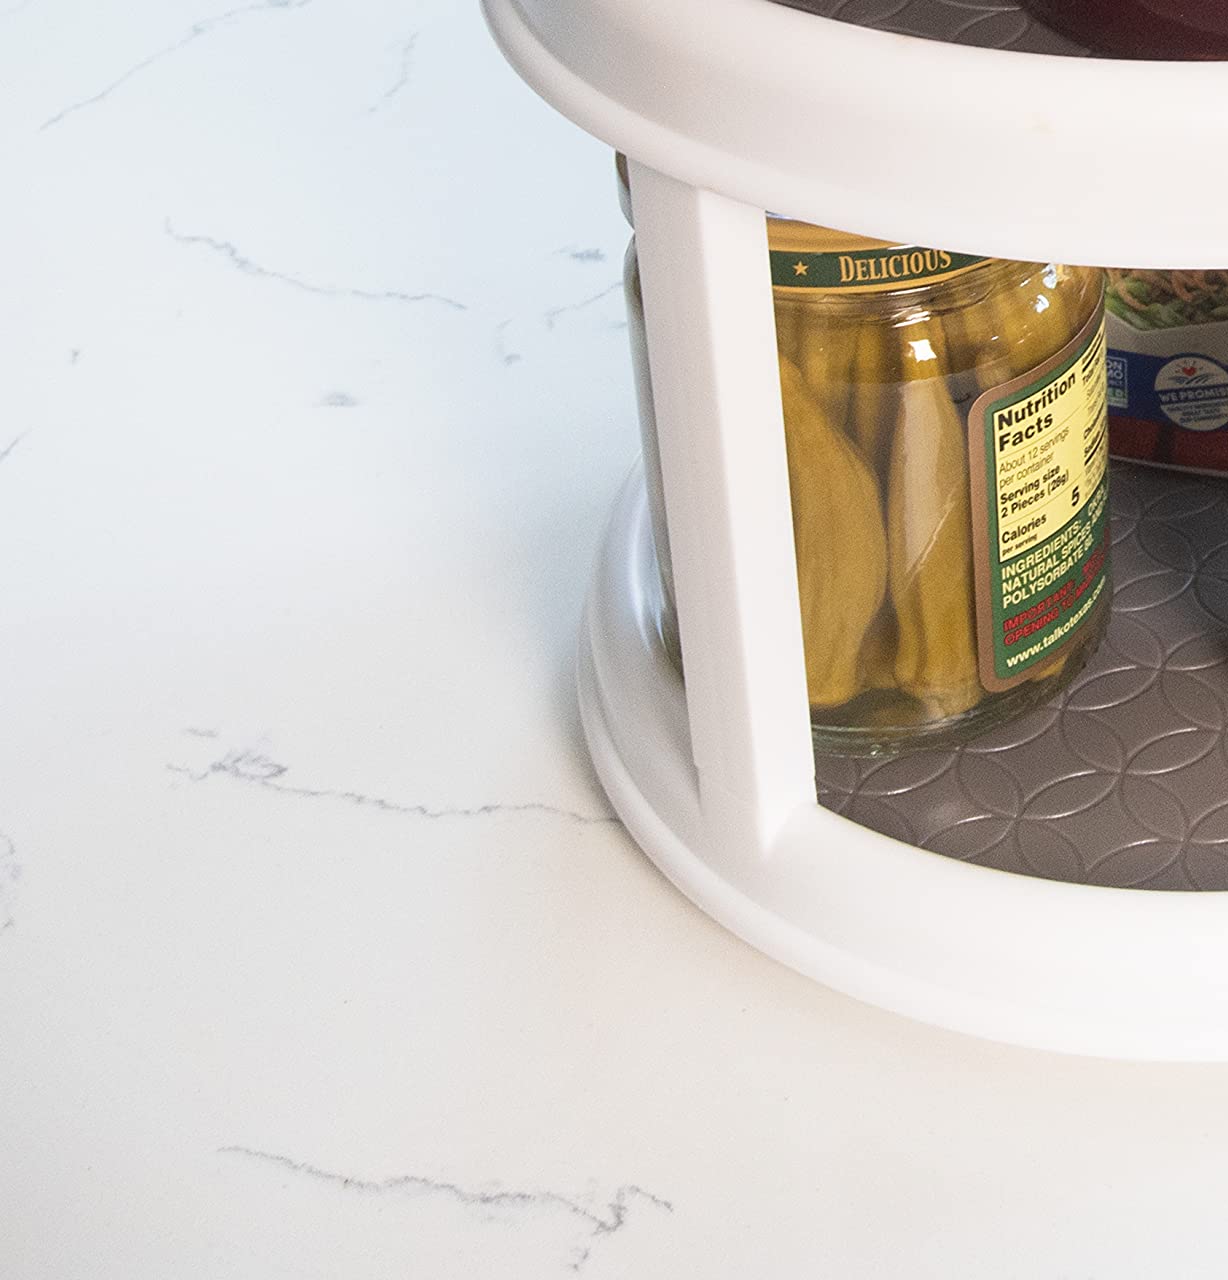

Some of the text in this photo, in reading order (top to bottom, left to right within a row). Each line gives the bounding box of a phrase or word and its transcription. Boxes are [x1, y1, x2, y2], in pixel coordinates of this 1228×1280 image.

[839, 247, 951, 283] DELICIOUS
[997, 372, 1076, 432] Nutrition
[1158, 392, 1178, 403] WE
[998, 412, 1053, 452] Facts
[998, 454, 1026, 475] About
[1027, 449, 1039, 462] 12
[1039, 425, 1070, 455] servings
[999, 451, 1054, 493] per container
[1000, 478, 1040, 505] Serving
[1042, 465, 1061, 483] size
[1001, 506, 1009, 519] 2
[1011, 488, 1045, 515] Pieces
[1001, 513, 1047, 544] Calories
[1071, 485, 1080, 507] 5
[1001, 519, 1082, 581] INGREDIENTS:
[1002, 555, 1059, 595] NATURAL
[1002, 547, 1084, 610] POLYSORBATE
[1004, 606, 1060, 647] OPENING
